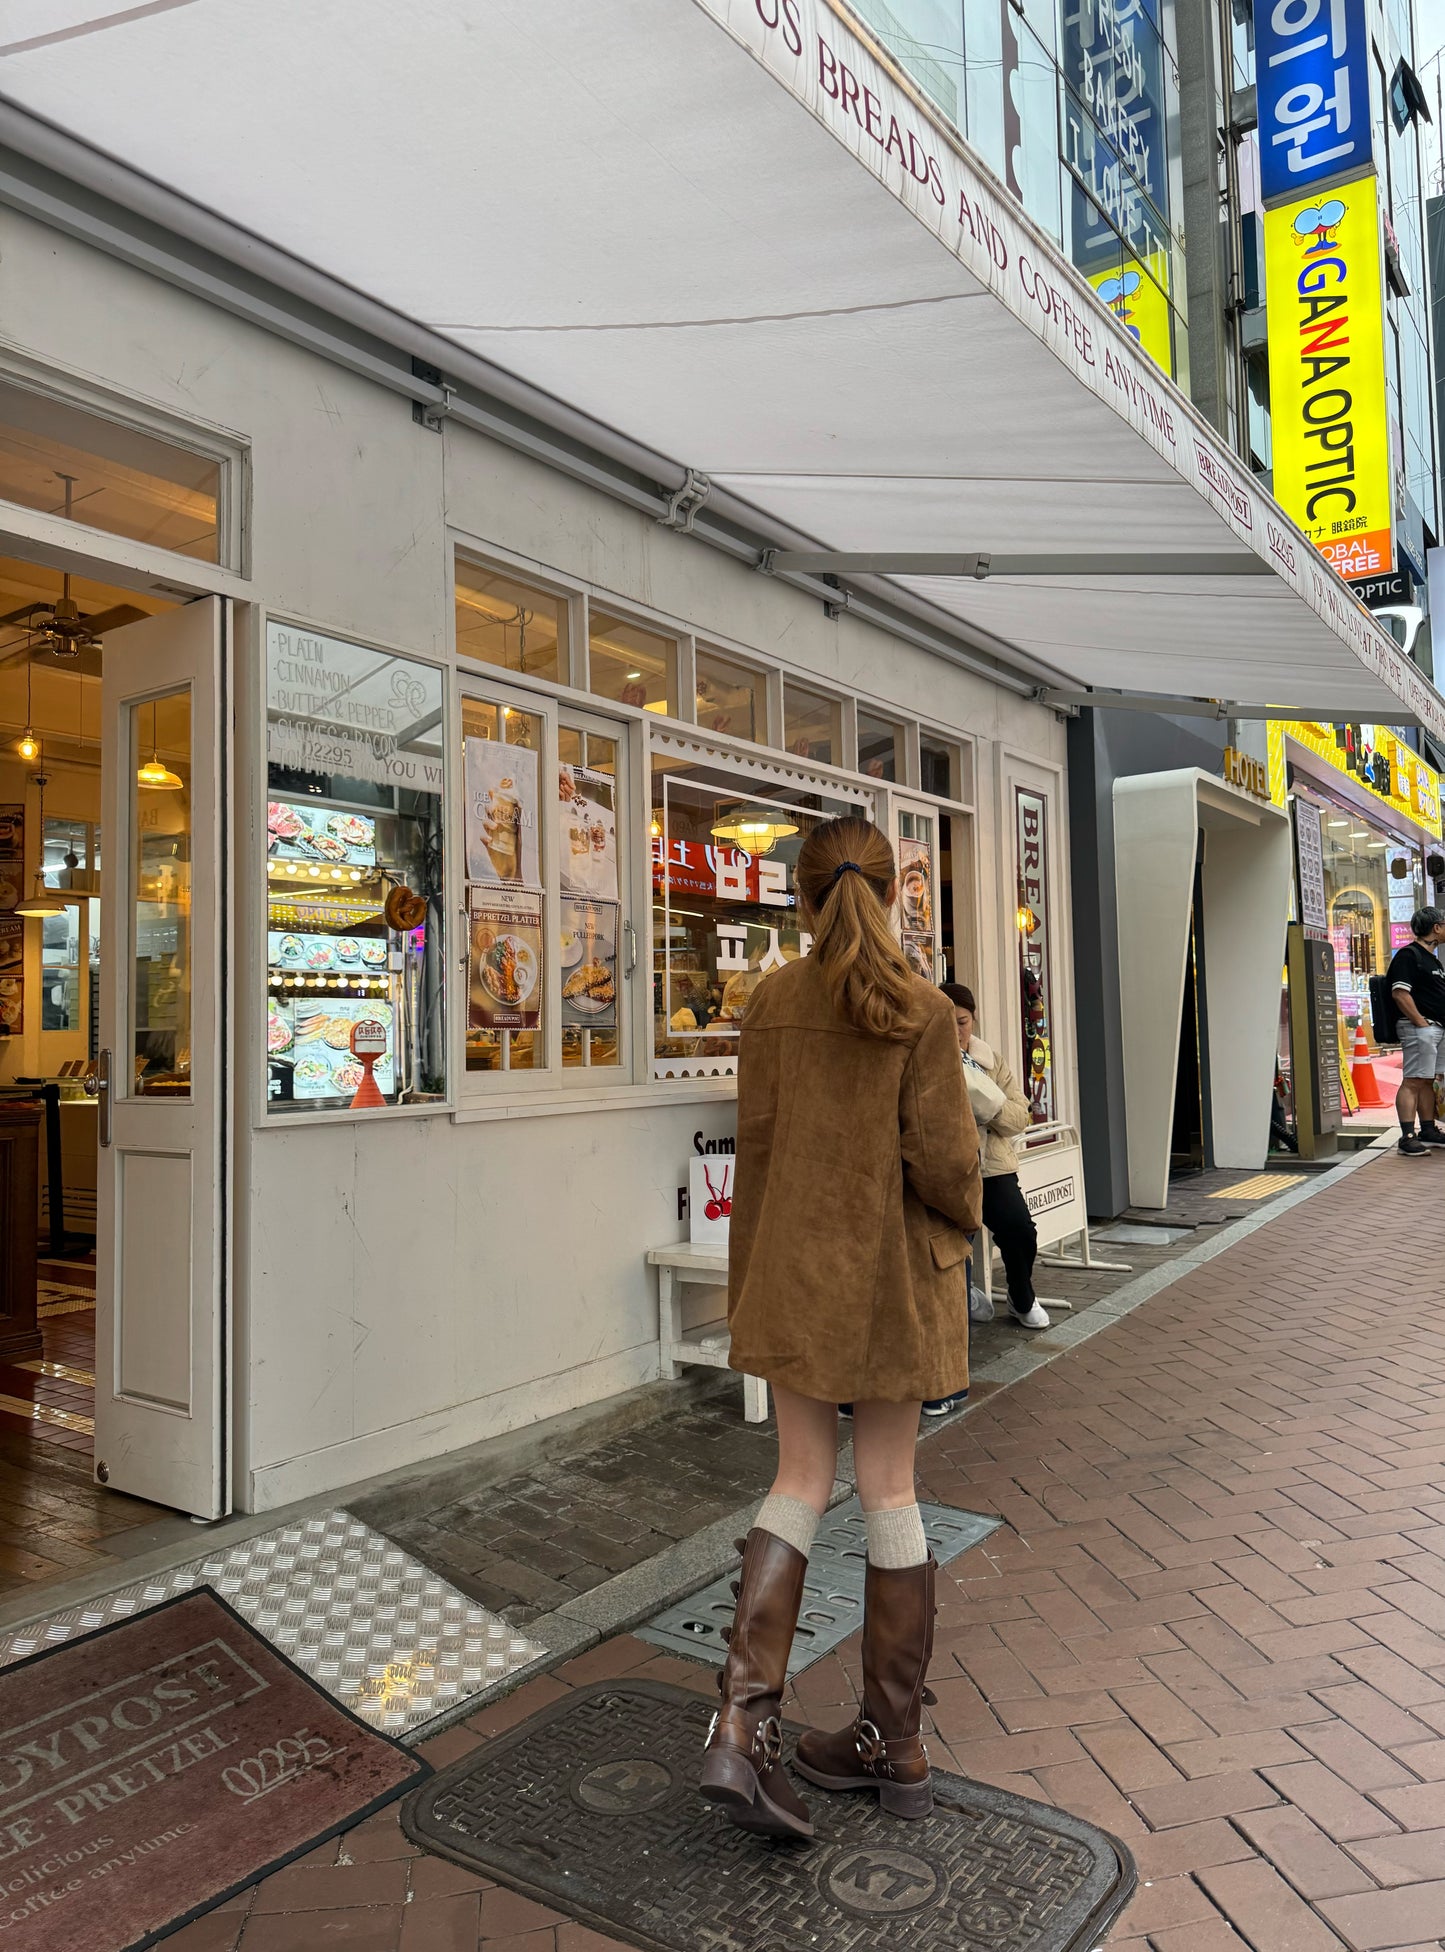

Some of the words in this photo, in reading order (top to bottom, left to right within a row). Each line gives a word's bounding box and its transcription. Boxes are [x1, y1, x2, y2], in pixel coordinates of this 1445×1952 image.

[817, 33, 946, 206] BREADS
[958, 190, 1008, 270] AND
[1019, 256, 1095, 367] COFFEE
[1104, 347, 1177, 447] ANYTIME
[278, 632, 324, 664] PLAIN
[276, 659, 350, 694] CINNAMON
[277, 690, 331, 717] BUTTER
[334, 700, 344, 719] &
[348, 702, 397, 731] PEPPER
[384, 757, 416, 780] YOU
[473, 911, 482, 920] BP
[483, 912, 511, 922] PRETZEL
[512, 914, 540, 925] PLATTER
[1028, 1182, 1073, 1212] BREADYPOST
[53, 1725, 239, 1826] PRETZEL
[221, 1728, 336, 1798] 02295
[88, 1823, 199, 1879] anytime.
[833, 1855, 933, 1901] KT
